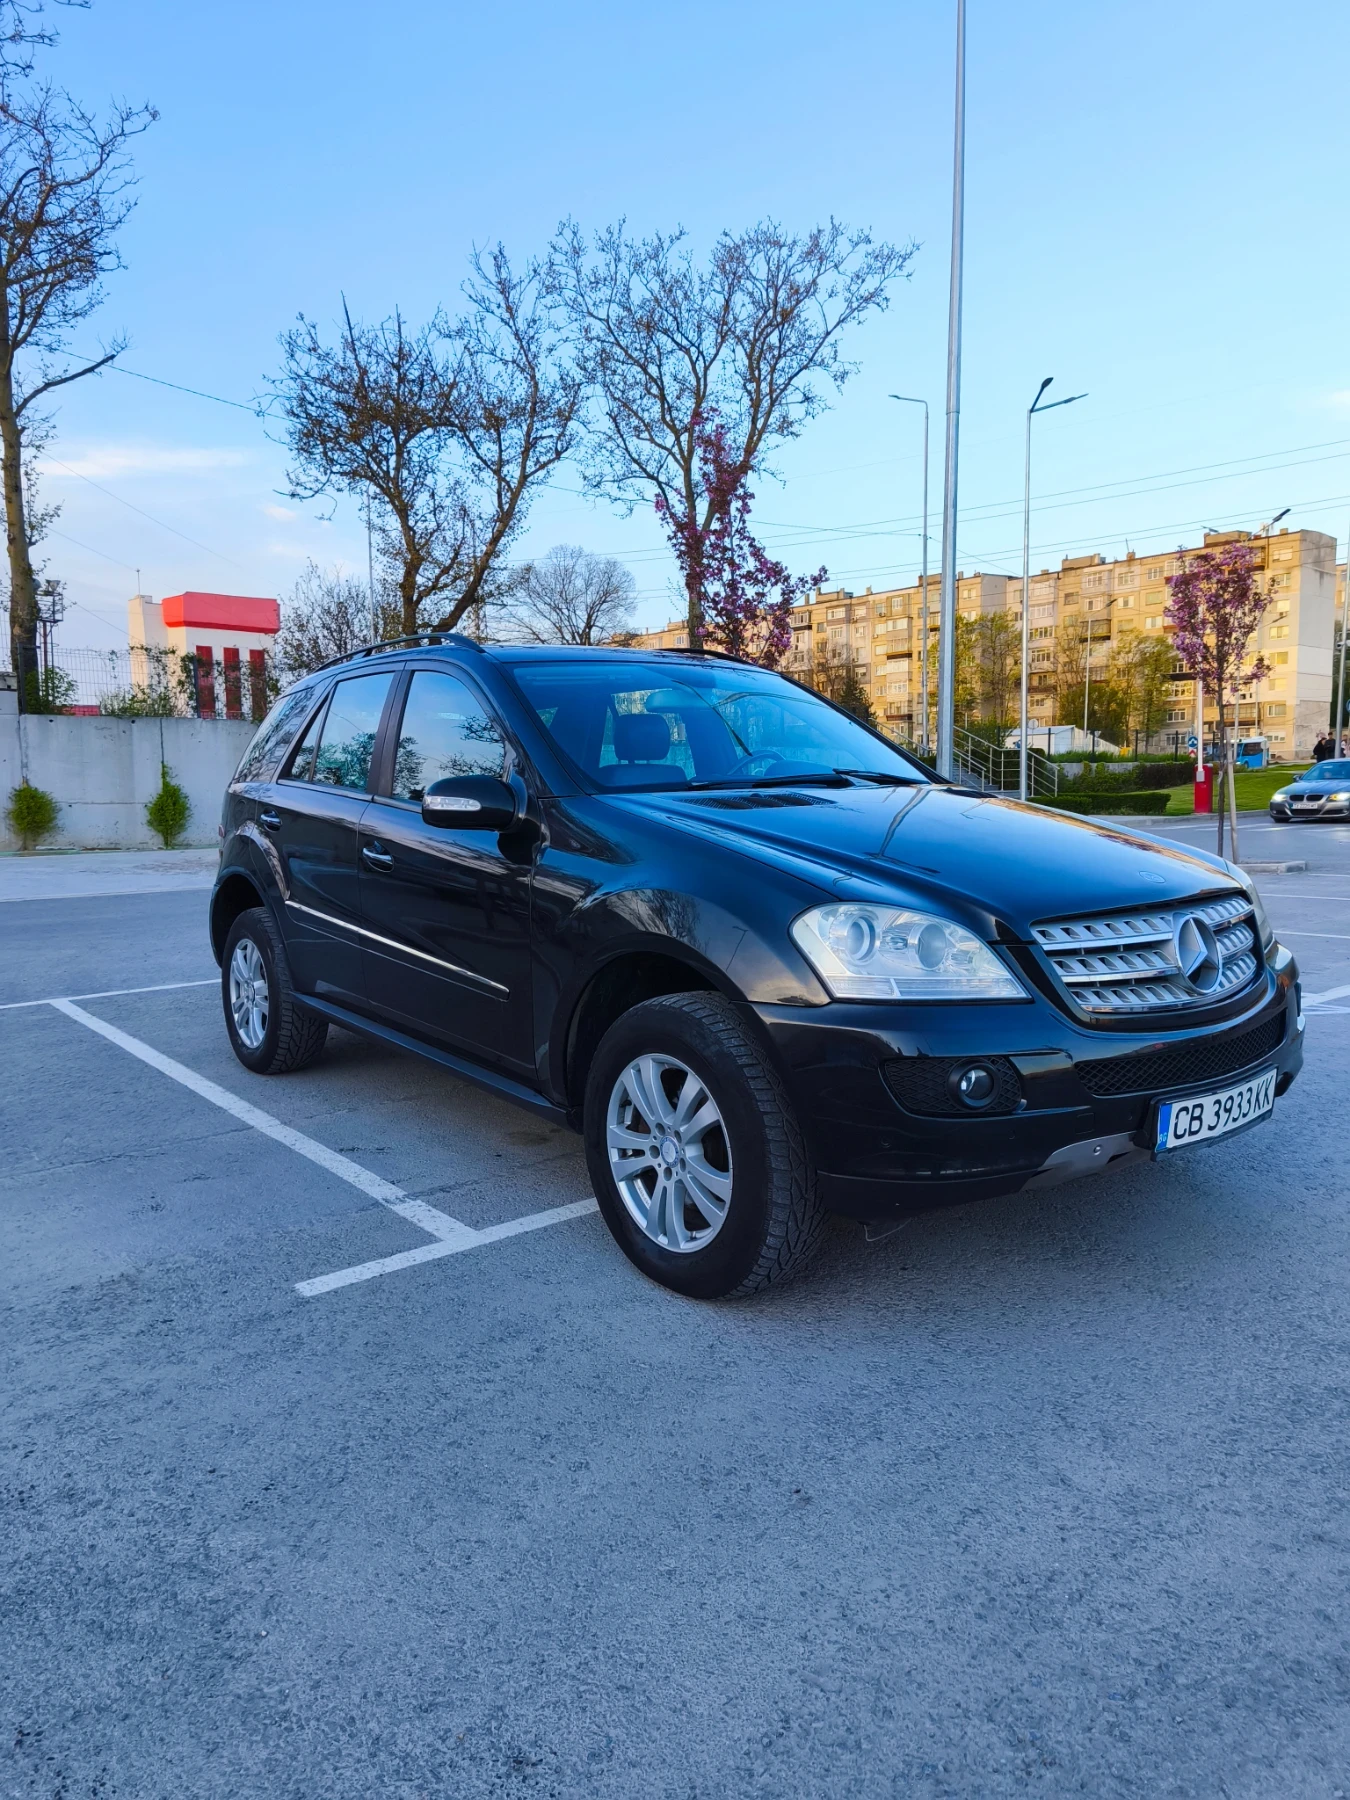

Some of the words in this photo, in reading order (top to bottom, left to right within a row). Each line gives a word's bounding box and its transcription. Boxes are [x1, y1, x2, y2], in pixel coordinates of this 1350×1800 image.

[1173, 1103, 1204, 1139] CB
[1207, 1086, 1253, 1131] 3933
[1253, 1075, 1274, 1113] KK
